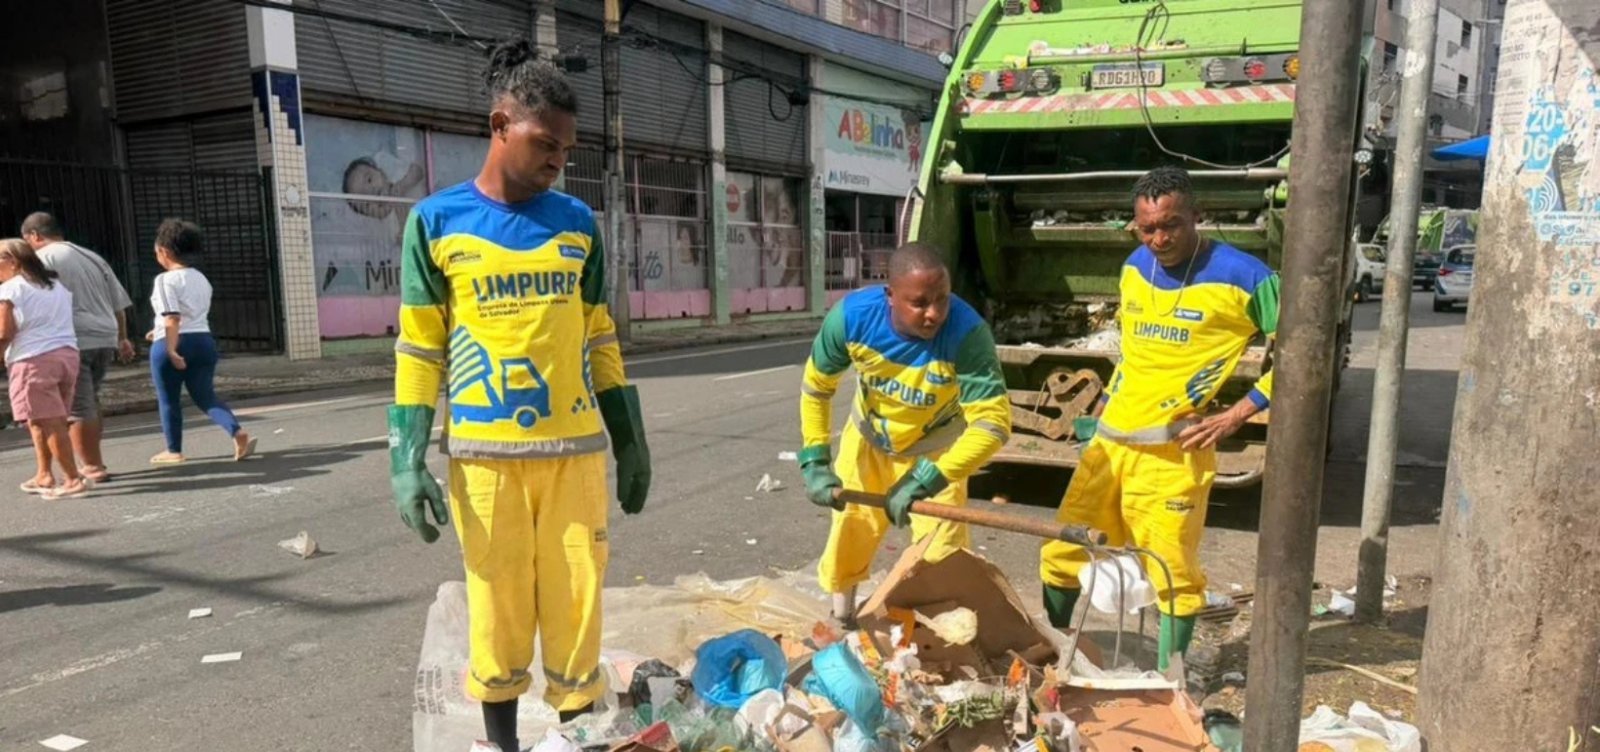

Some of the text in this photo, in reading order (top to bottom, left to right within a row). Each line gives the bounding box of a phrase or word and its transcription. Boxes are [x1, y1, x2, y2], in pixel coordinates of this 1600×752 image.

[472, 271, 577, 302] LIMPURB
[1134, 320, 1190, 343] LIMPURB
[868, 375, 937, 407] IMPURB
